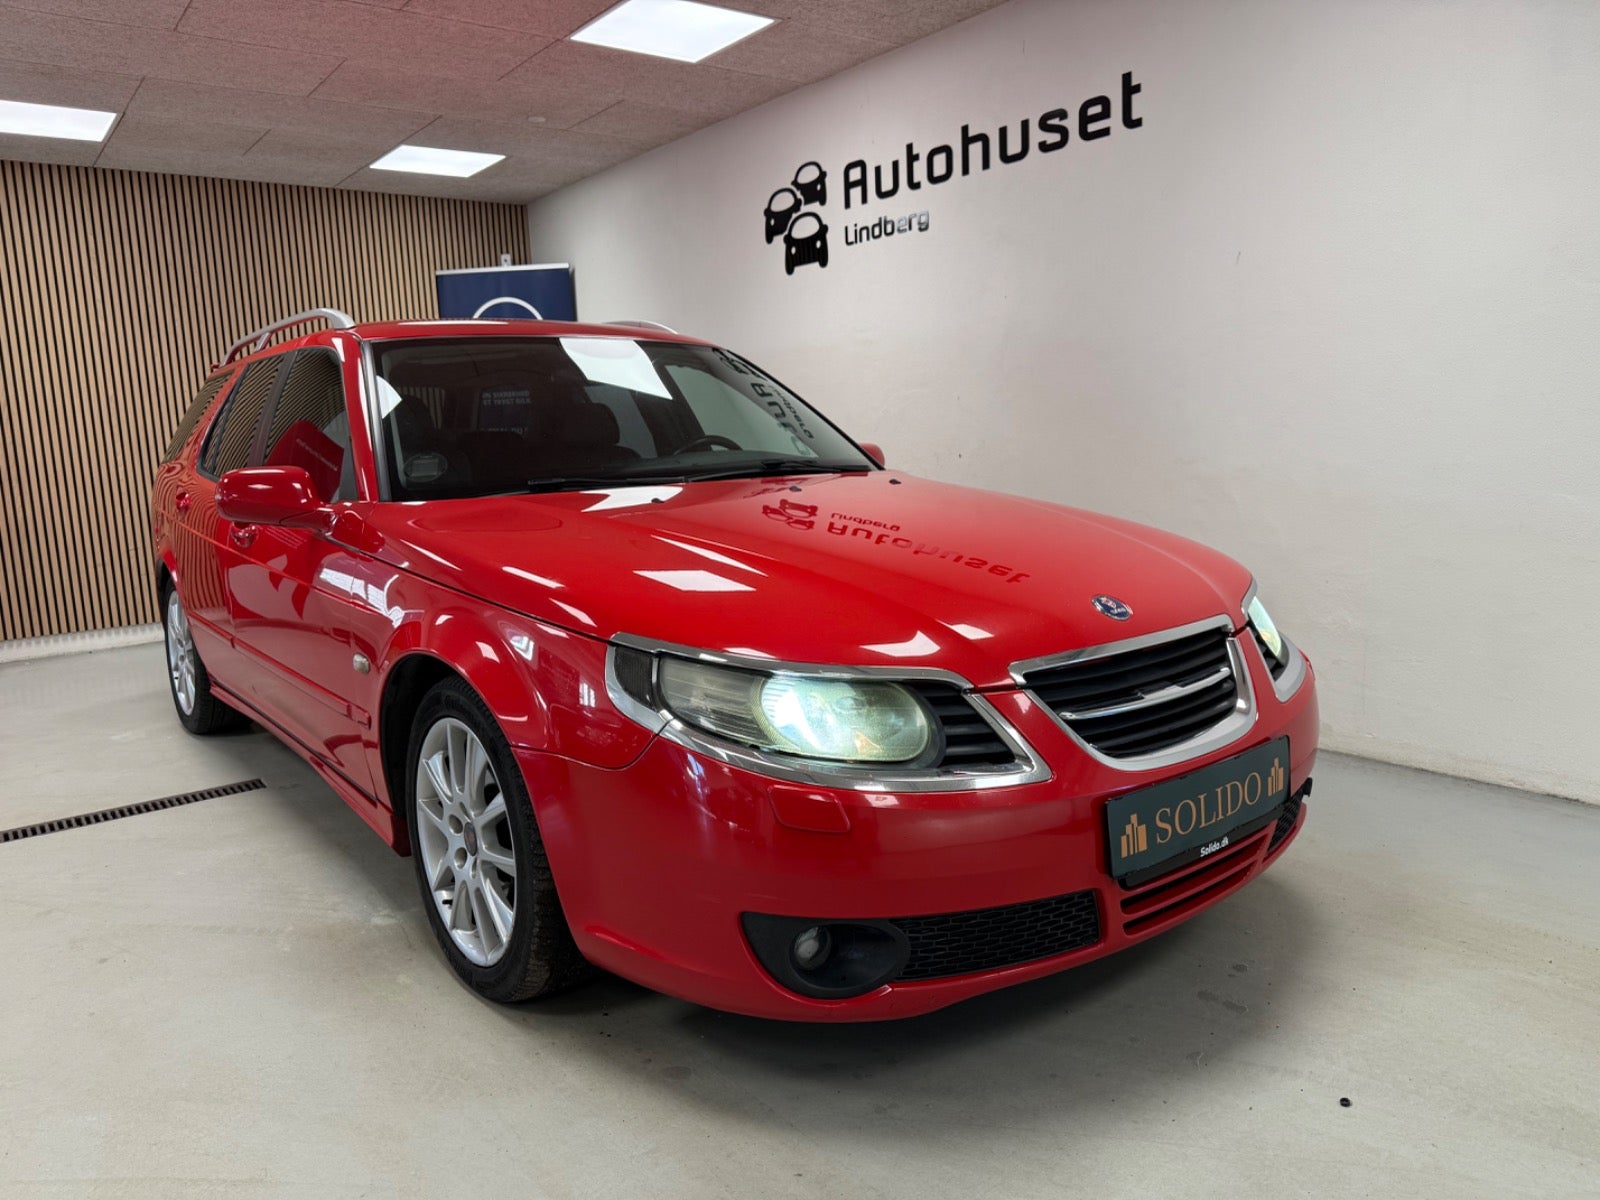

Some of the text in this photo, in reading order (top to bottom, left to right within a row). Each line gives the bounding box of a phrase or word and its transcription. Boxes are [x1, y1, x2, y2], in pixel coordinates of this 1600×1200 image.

[843, 71, 1143, 210] Autohuset
[844, 210, 930, 246] Lindberg
[1155, 771, 1262, 844] SOLIDO
[1200, 836, 1229, 857] Solido.dk
